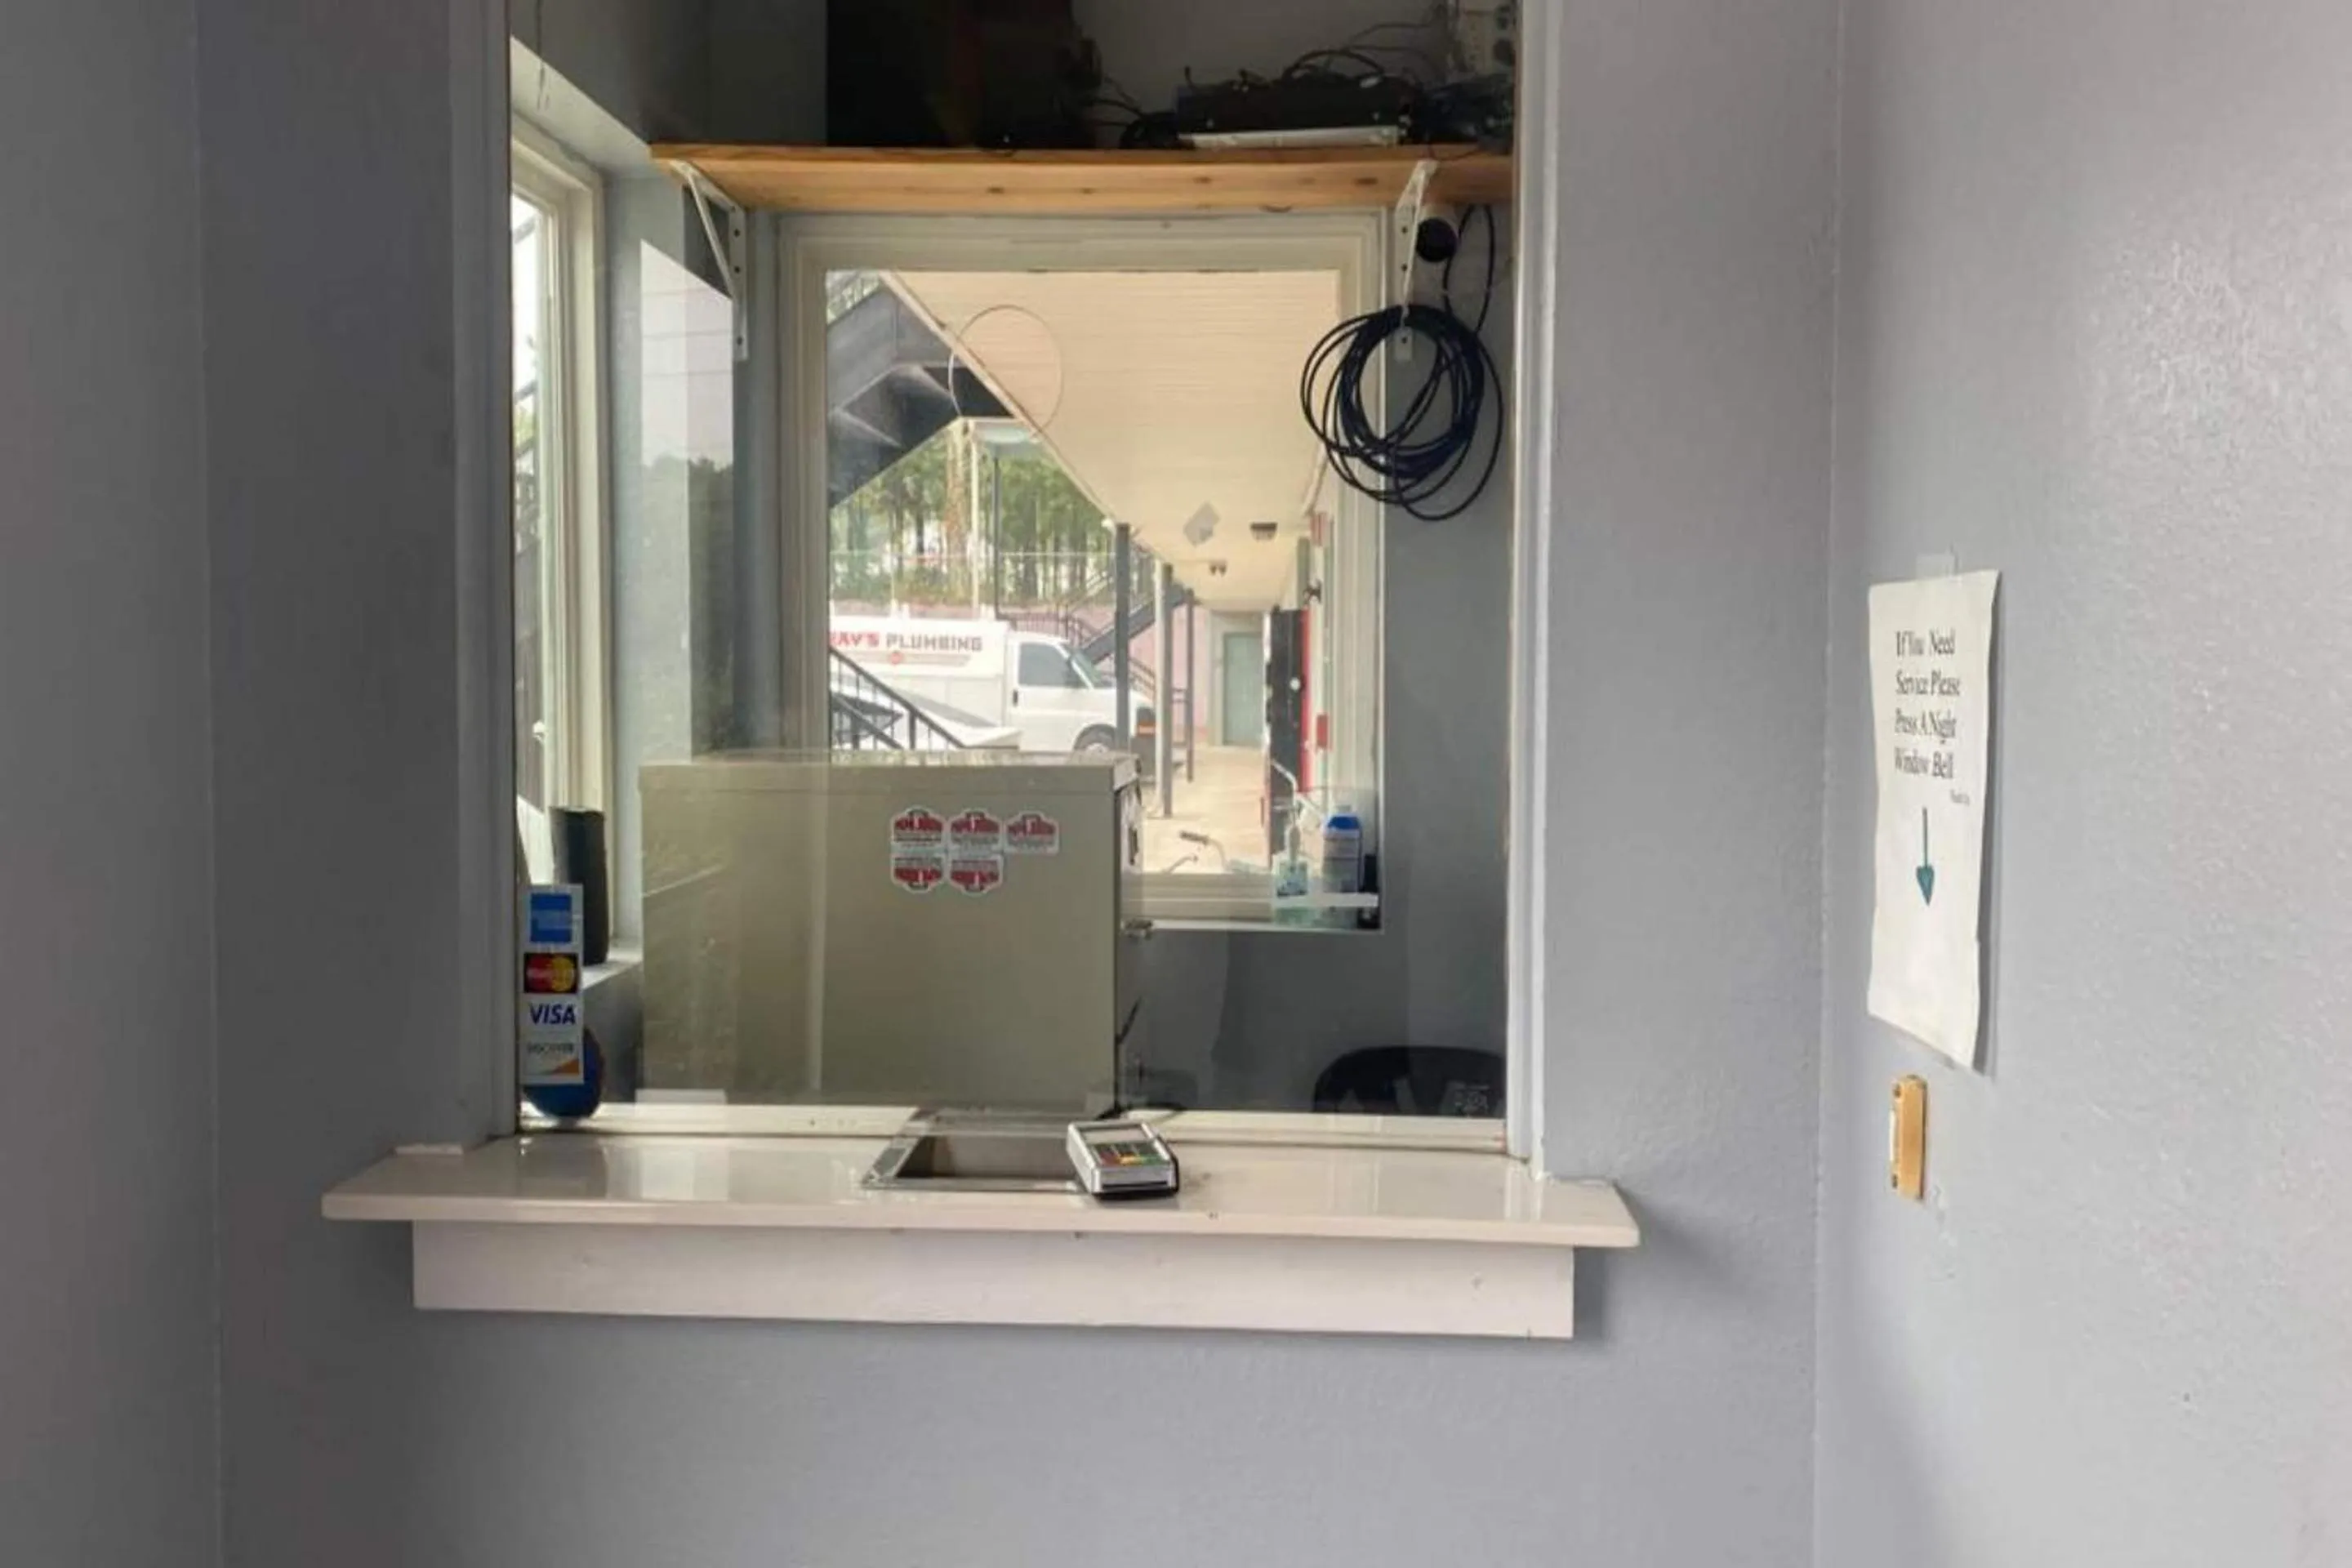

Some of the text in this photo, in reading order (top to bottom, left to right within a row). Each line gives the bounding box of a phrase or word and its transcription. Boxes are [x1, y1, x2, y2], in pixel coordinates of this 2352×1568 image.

[886, 633, 982, 652] PLUMBING
[1929, 628, 1956, 656] Need
[1895, 668, 1960, 696] Service Please
[1895, 707, 1917, 735] Press
[1929, 710, 1957, 744] Night
[1894, 747, 1953, 779] Window Bell
[528, 1003, 576, 1025] VISA
